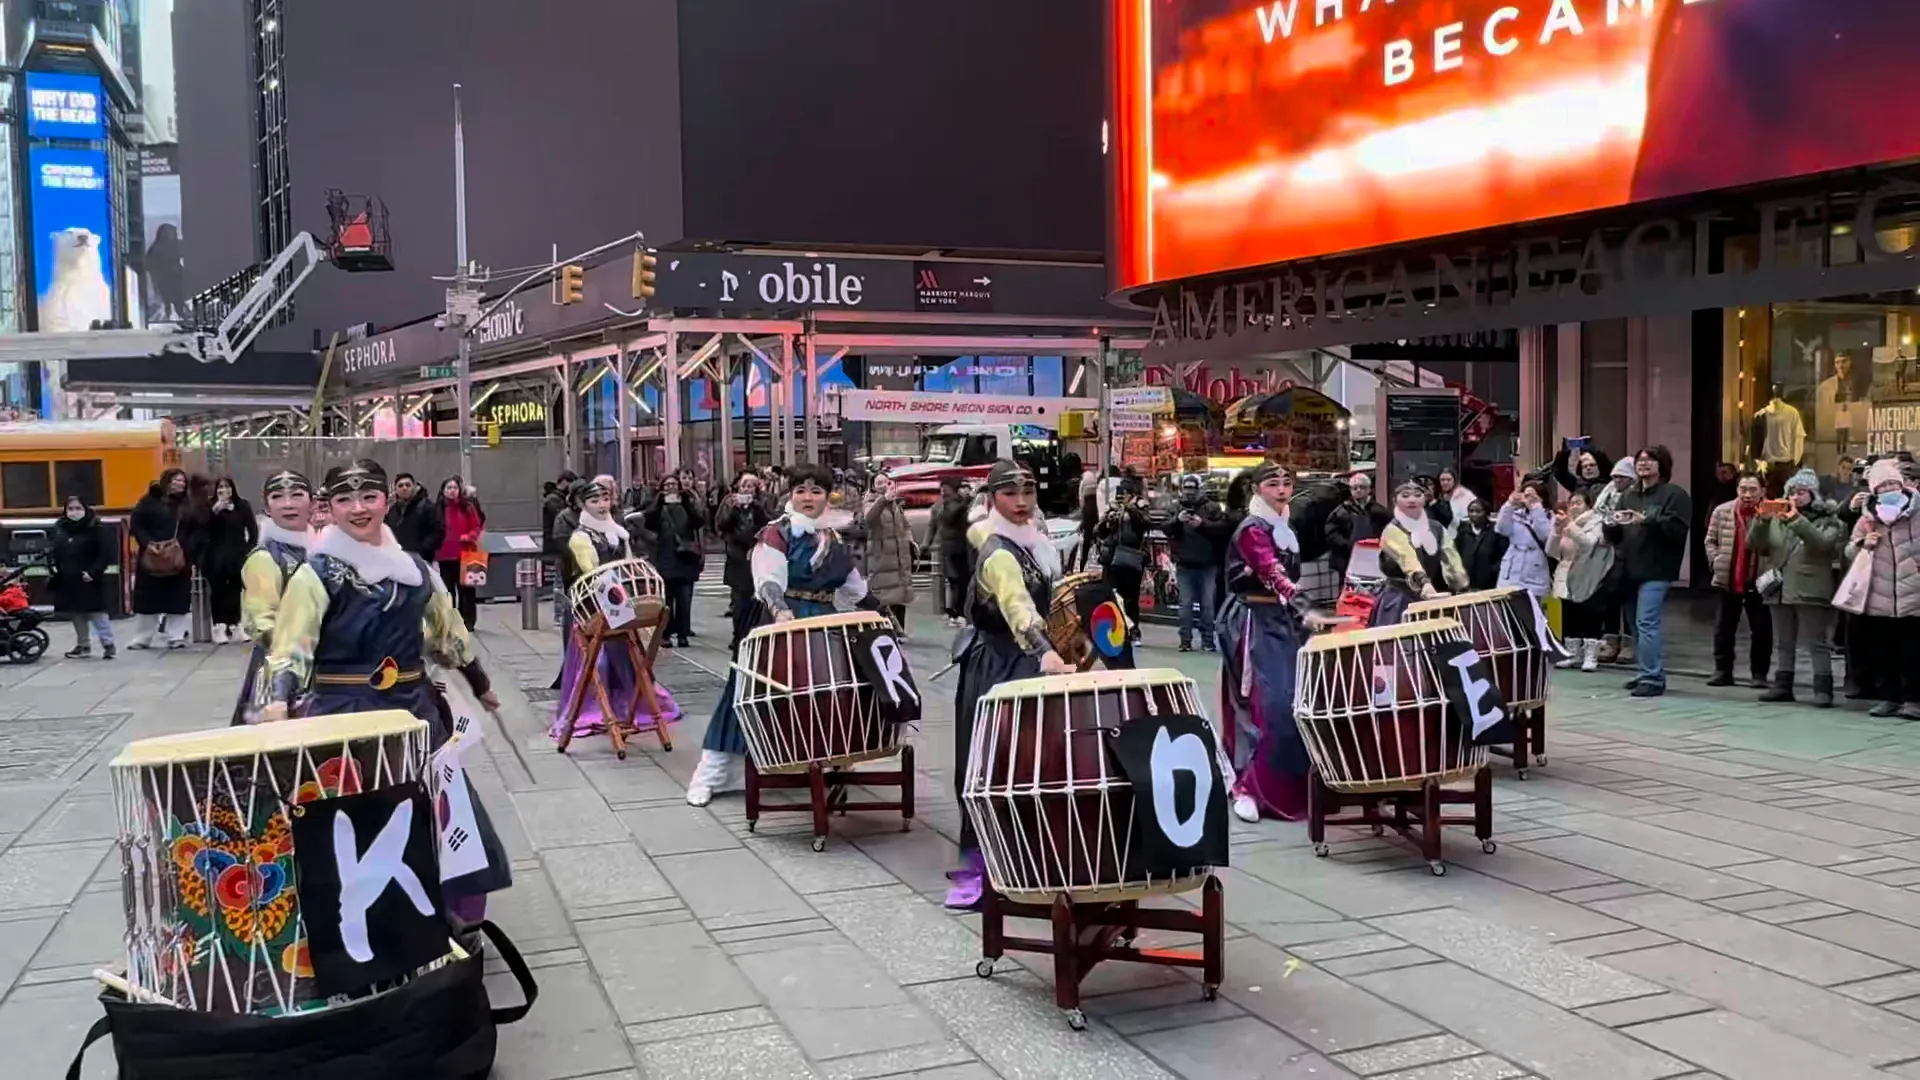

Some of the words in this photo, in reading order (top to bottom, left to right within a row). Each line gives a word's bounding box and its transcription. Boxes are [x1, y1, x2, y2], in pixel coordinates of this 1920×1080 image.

[959, 291, 991, 299] MARQUIS
[344, 338, 396, 373] SEPHORA
[491, 401, 544, 424] SEPHORA
[865, 400, 906, 411] NORTH
[910, 401, 949, 412] SHORE
[951, 402, 985, 413] NEON
[987, 404, 1014, 414] SIGN
[1015, 405, 1033, 415] CO.
[1867, 431, 1905, 456] EAGLE
[870, 635, 920, 708] R
[1448, 648, 1504, 741] E
[1150, 725, 1214, 848] O
[333, 798, 435, 963] K
